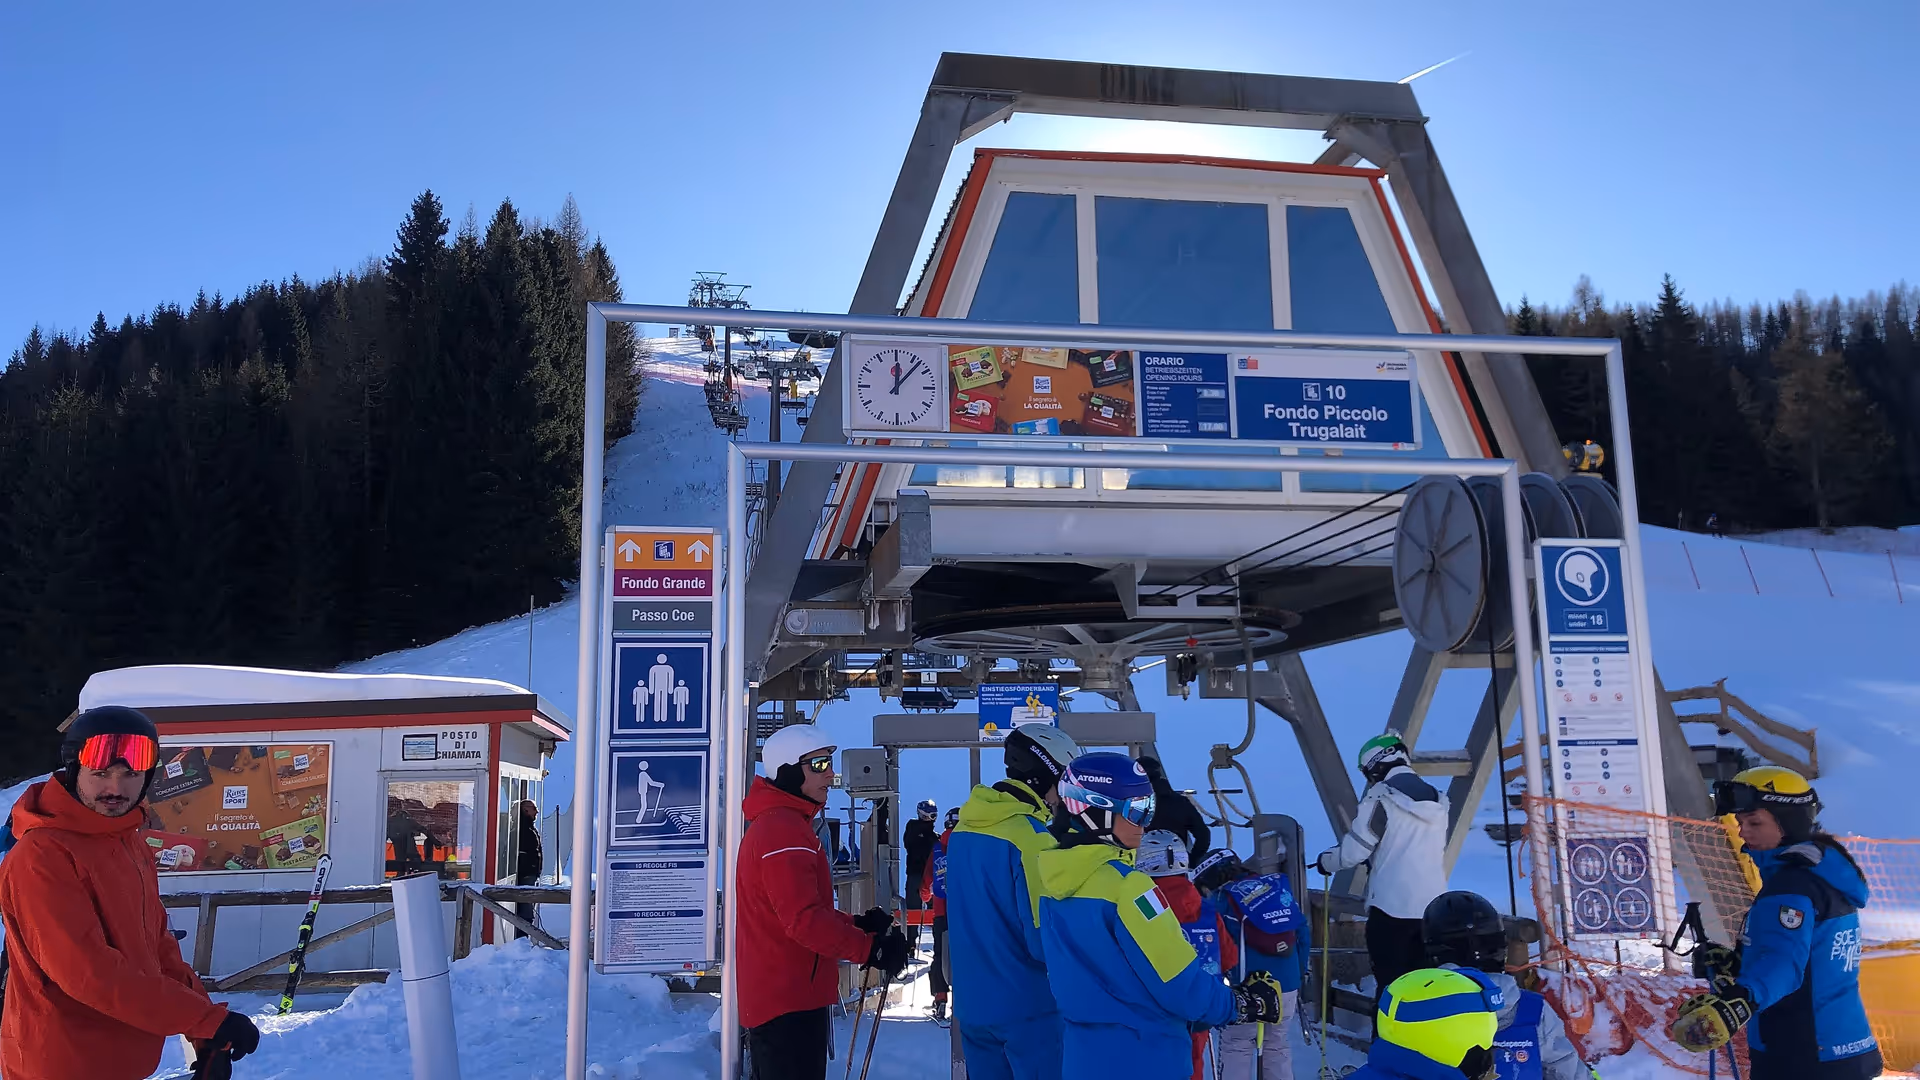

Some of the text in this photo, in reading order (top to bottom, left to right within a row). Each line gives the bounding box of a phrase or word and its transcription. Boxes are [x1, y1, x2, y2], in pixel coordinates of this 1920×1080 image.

[1145, 356, 1184, 366] ORARIO
[1325, 385, 1347, 400] 10
[1033, 402, 1063, 410] QUALITÀ
[1264, 403, 1388, 421] Fondo Piccolo
[1288, 422, 1367, 441] Trugalait
[621, 576, 706, 589] Fondo Grande
[632, 609, 695, 621] Passo Coe
[1590, 614, 1604, 626] 18
[926, 672, 931, 681] 1
[442, 731, 478, 740] POSTO
[455, 741, 466, 749] DI
[436, 750, 482, 760] CHIAMATA
[1029, 745, 1060, 776] SALOMON
[1077, 774, 1113, 784] ATOMIC
[225, 789, 246, 799] Ritter
[214, 813, 219, 821] Il
[219, 814, 248, 823] segreto
[206, 820, 261, 831] LA QUALITÀ
